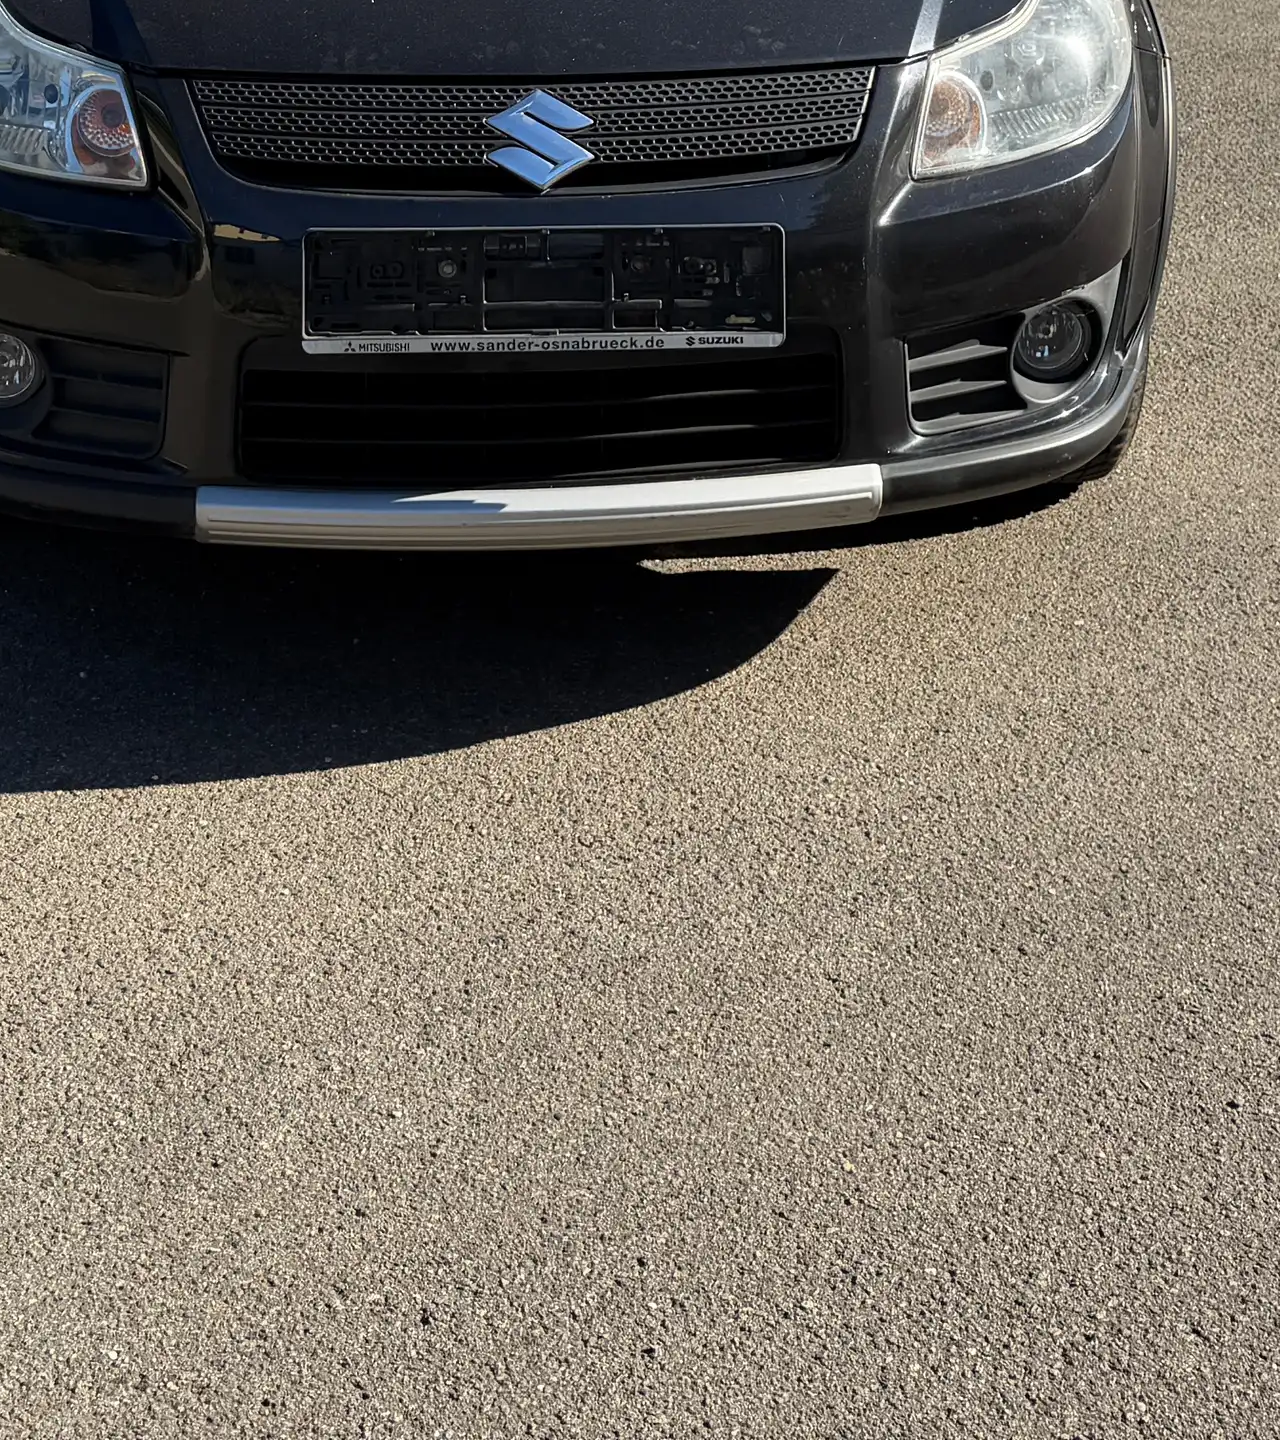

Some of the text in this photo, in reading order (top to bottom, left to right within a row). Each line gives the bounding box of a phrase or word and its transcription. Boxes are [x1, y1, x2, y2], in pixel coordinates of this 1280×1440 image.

[430, 336, 665, 352] www.sander-osnabrueck.de
[697, 336, 744, 345] SUZUKI
[358, 342, 410, 352] MITSUBISHI
